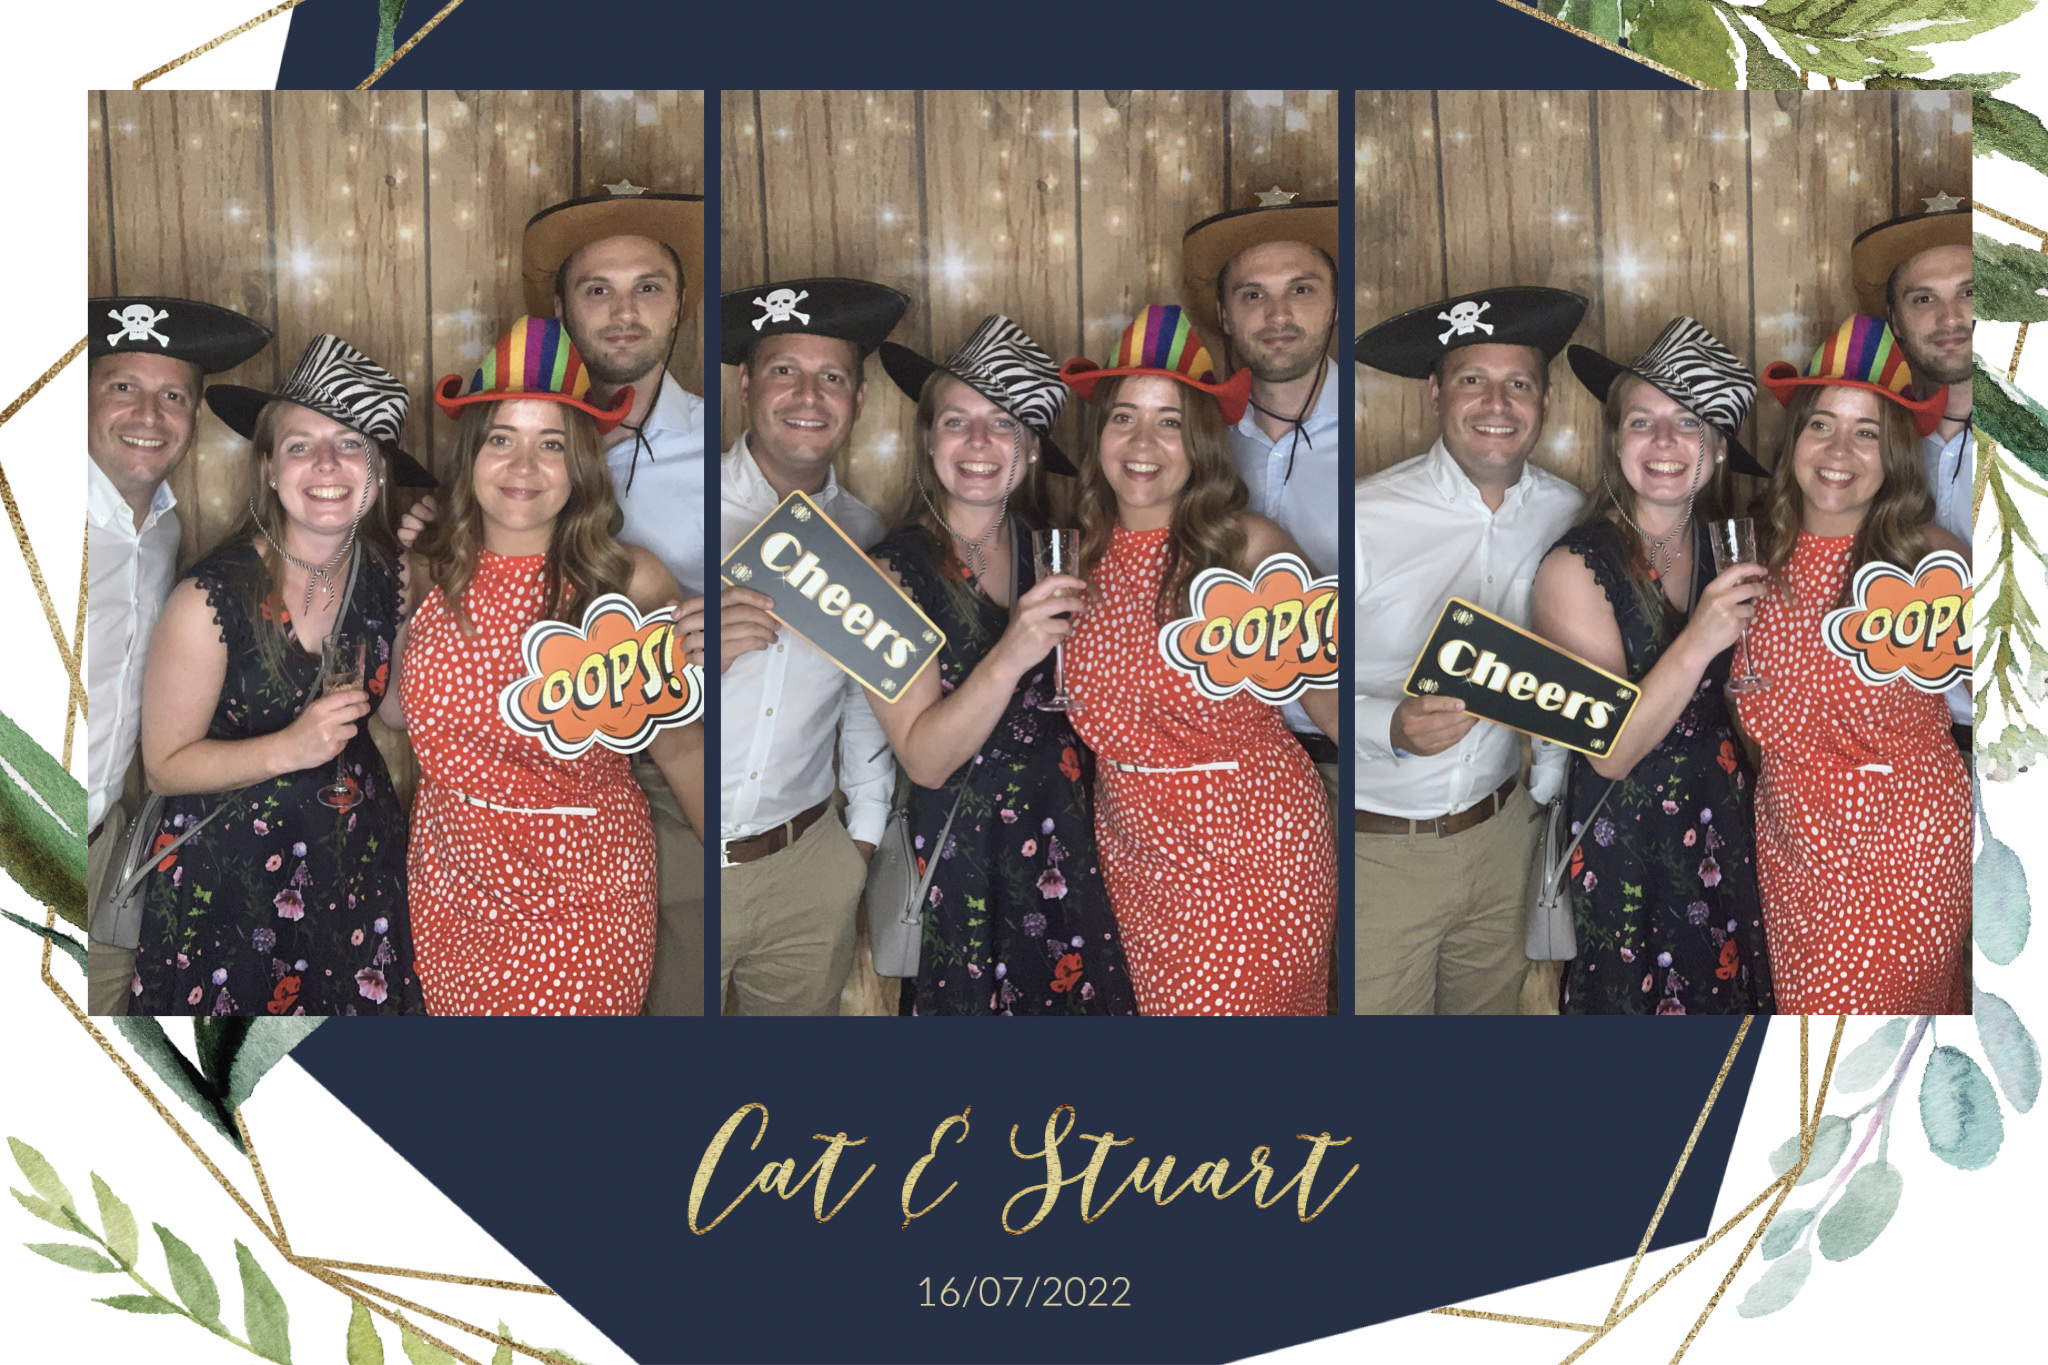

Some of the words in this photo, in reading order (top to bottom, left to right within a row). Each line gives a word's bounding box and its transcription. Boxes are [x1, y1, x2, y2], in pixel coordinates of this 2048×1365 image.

[760, 532, 916, 668] Cheers
[1195, 590, 1338, 663] OOPS!
[538, 623, 683, 714] OOPS!
[1437, 639, 1614, 729] Cheers
